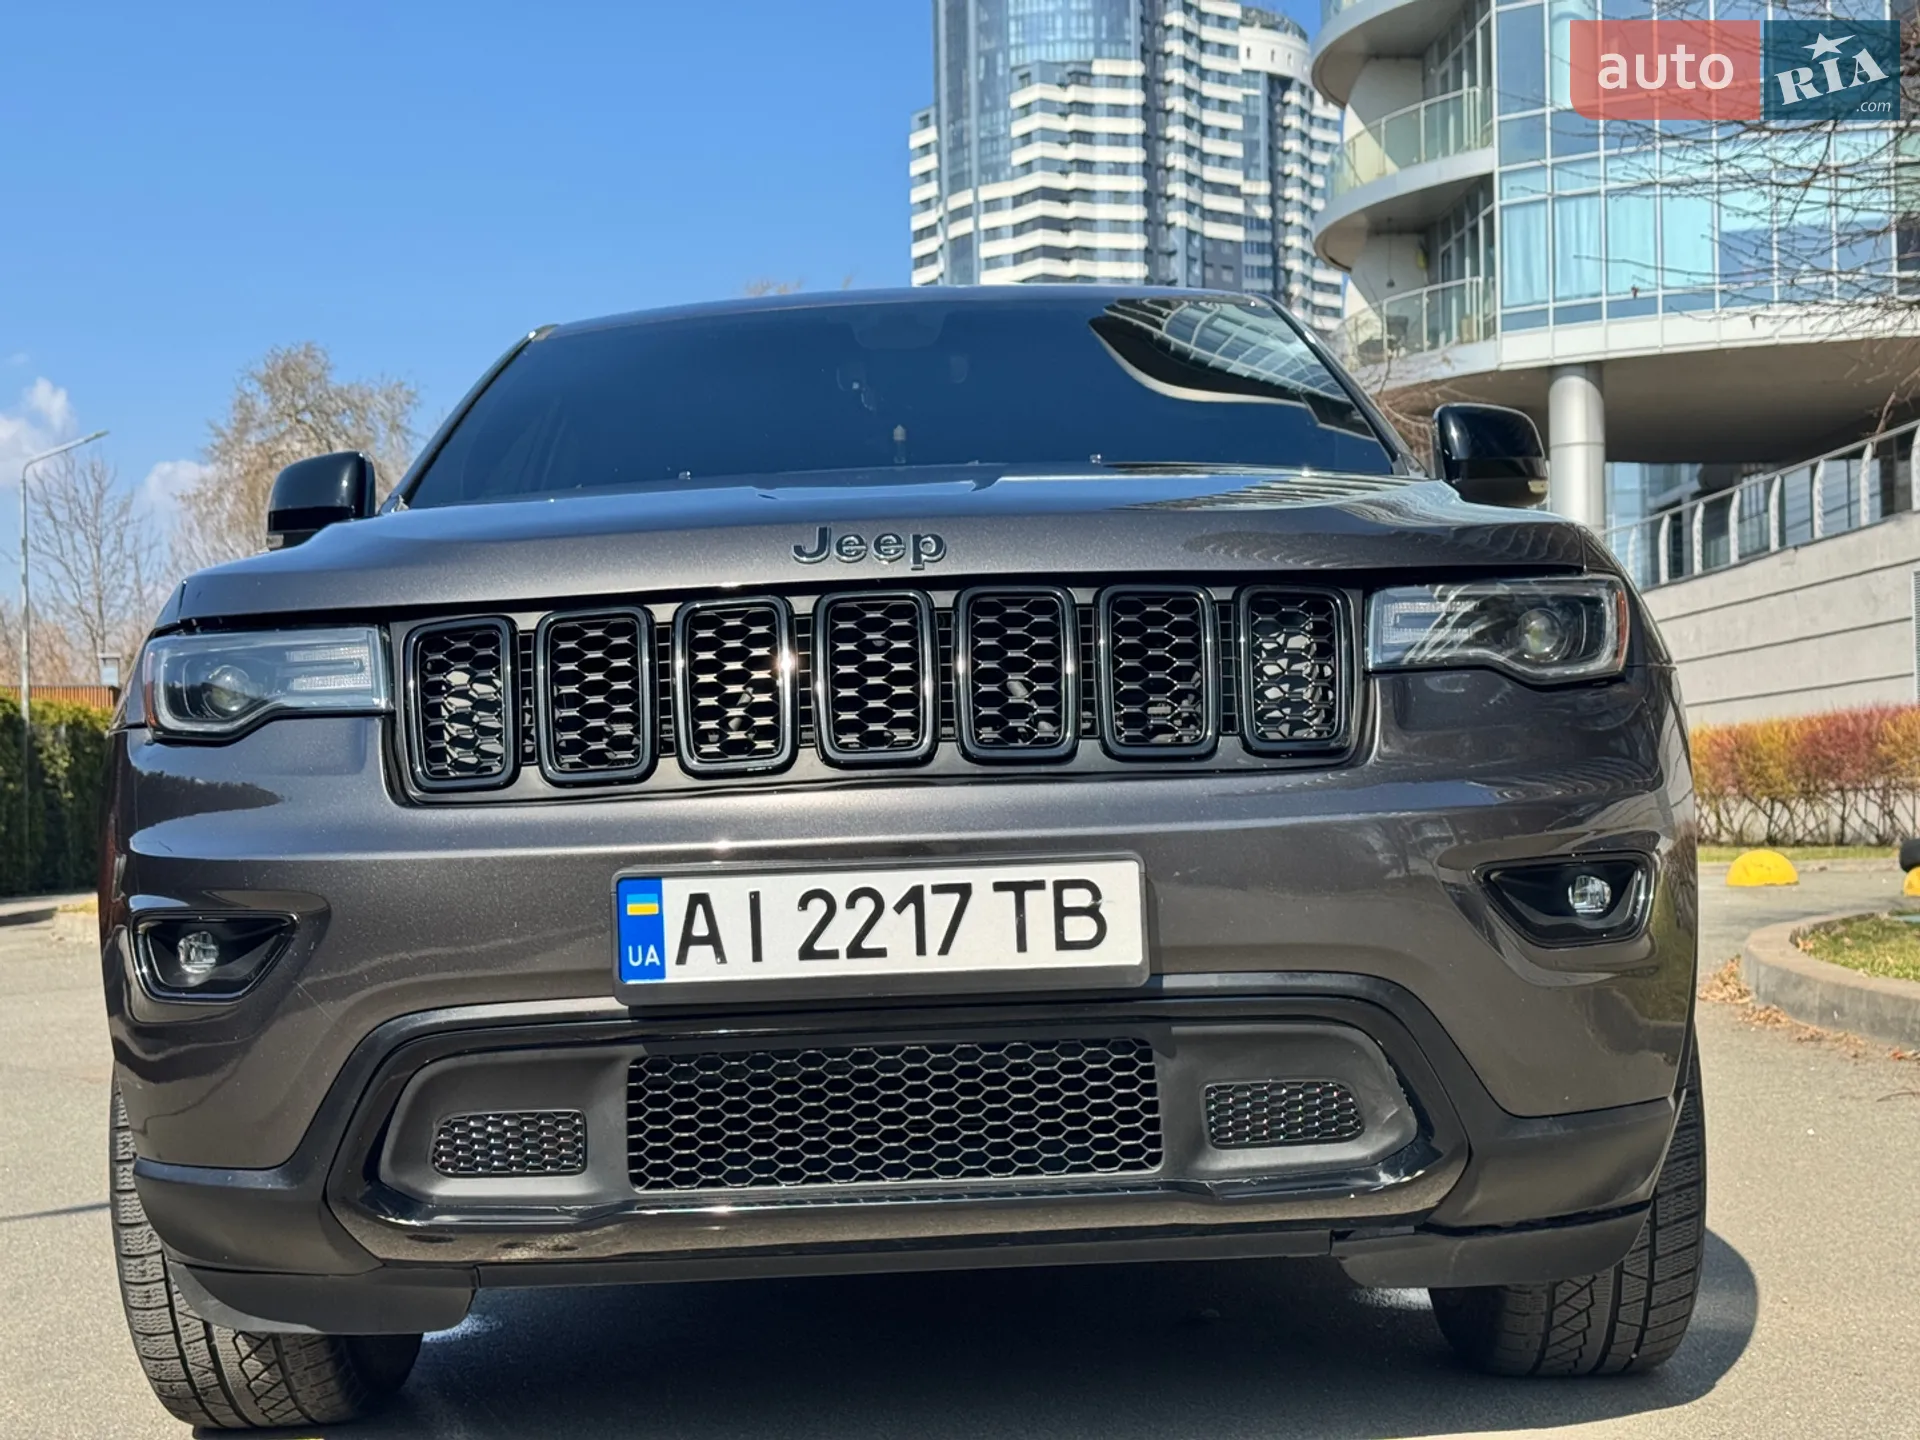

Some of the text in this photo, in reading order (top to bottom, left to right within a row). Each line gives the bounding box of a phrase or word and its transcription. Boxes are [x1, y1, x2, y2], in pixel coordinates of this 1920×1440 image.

[792, 526, 947, 570] Jeep
[675, 879, 1108, 965] AI 2217 TB
[628, 945, 660, 967] UA
